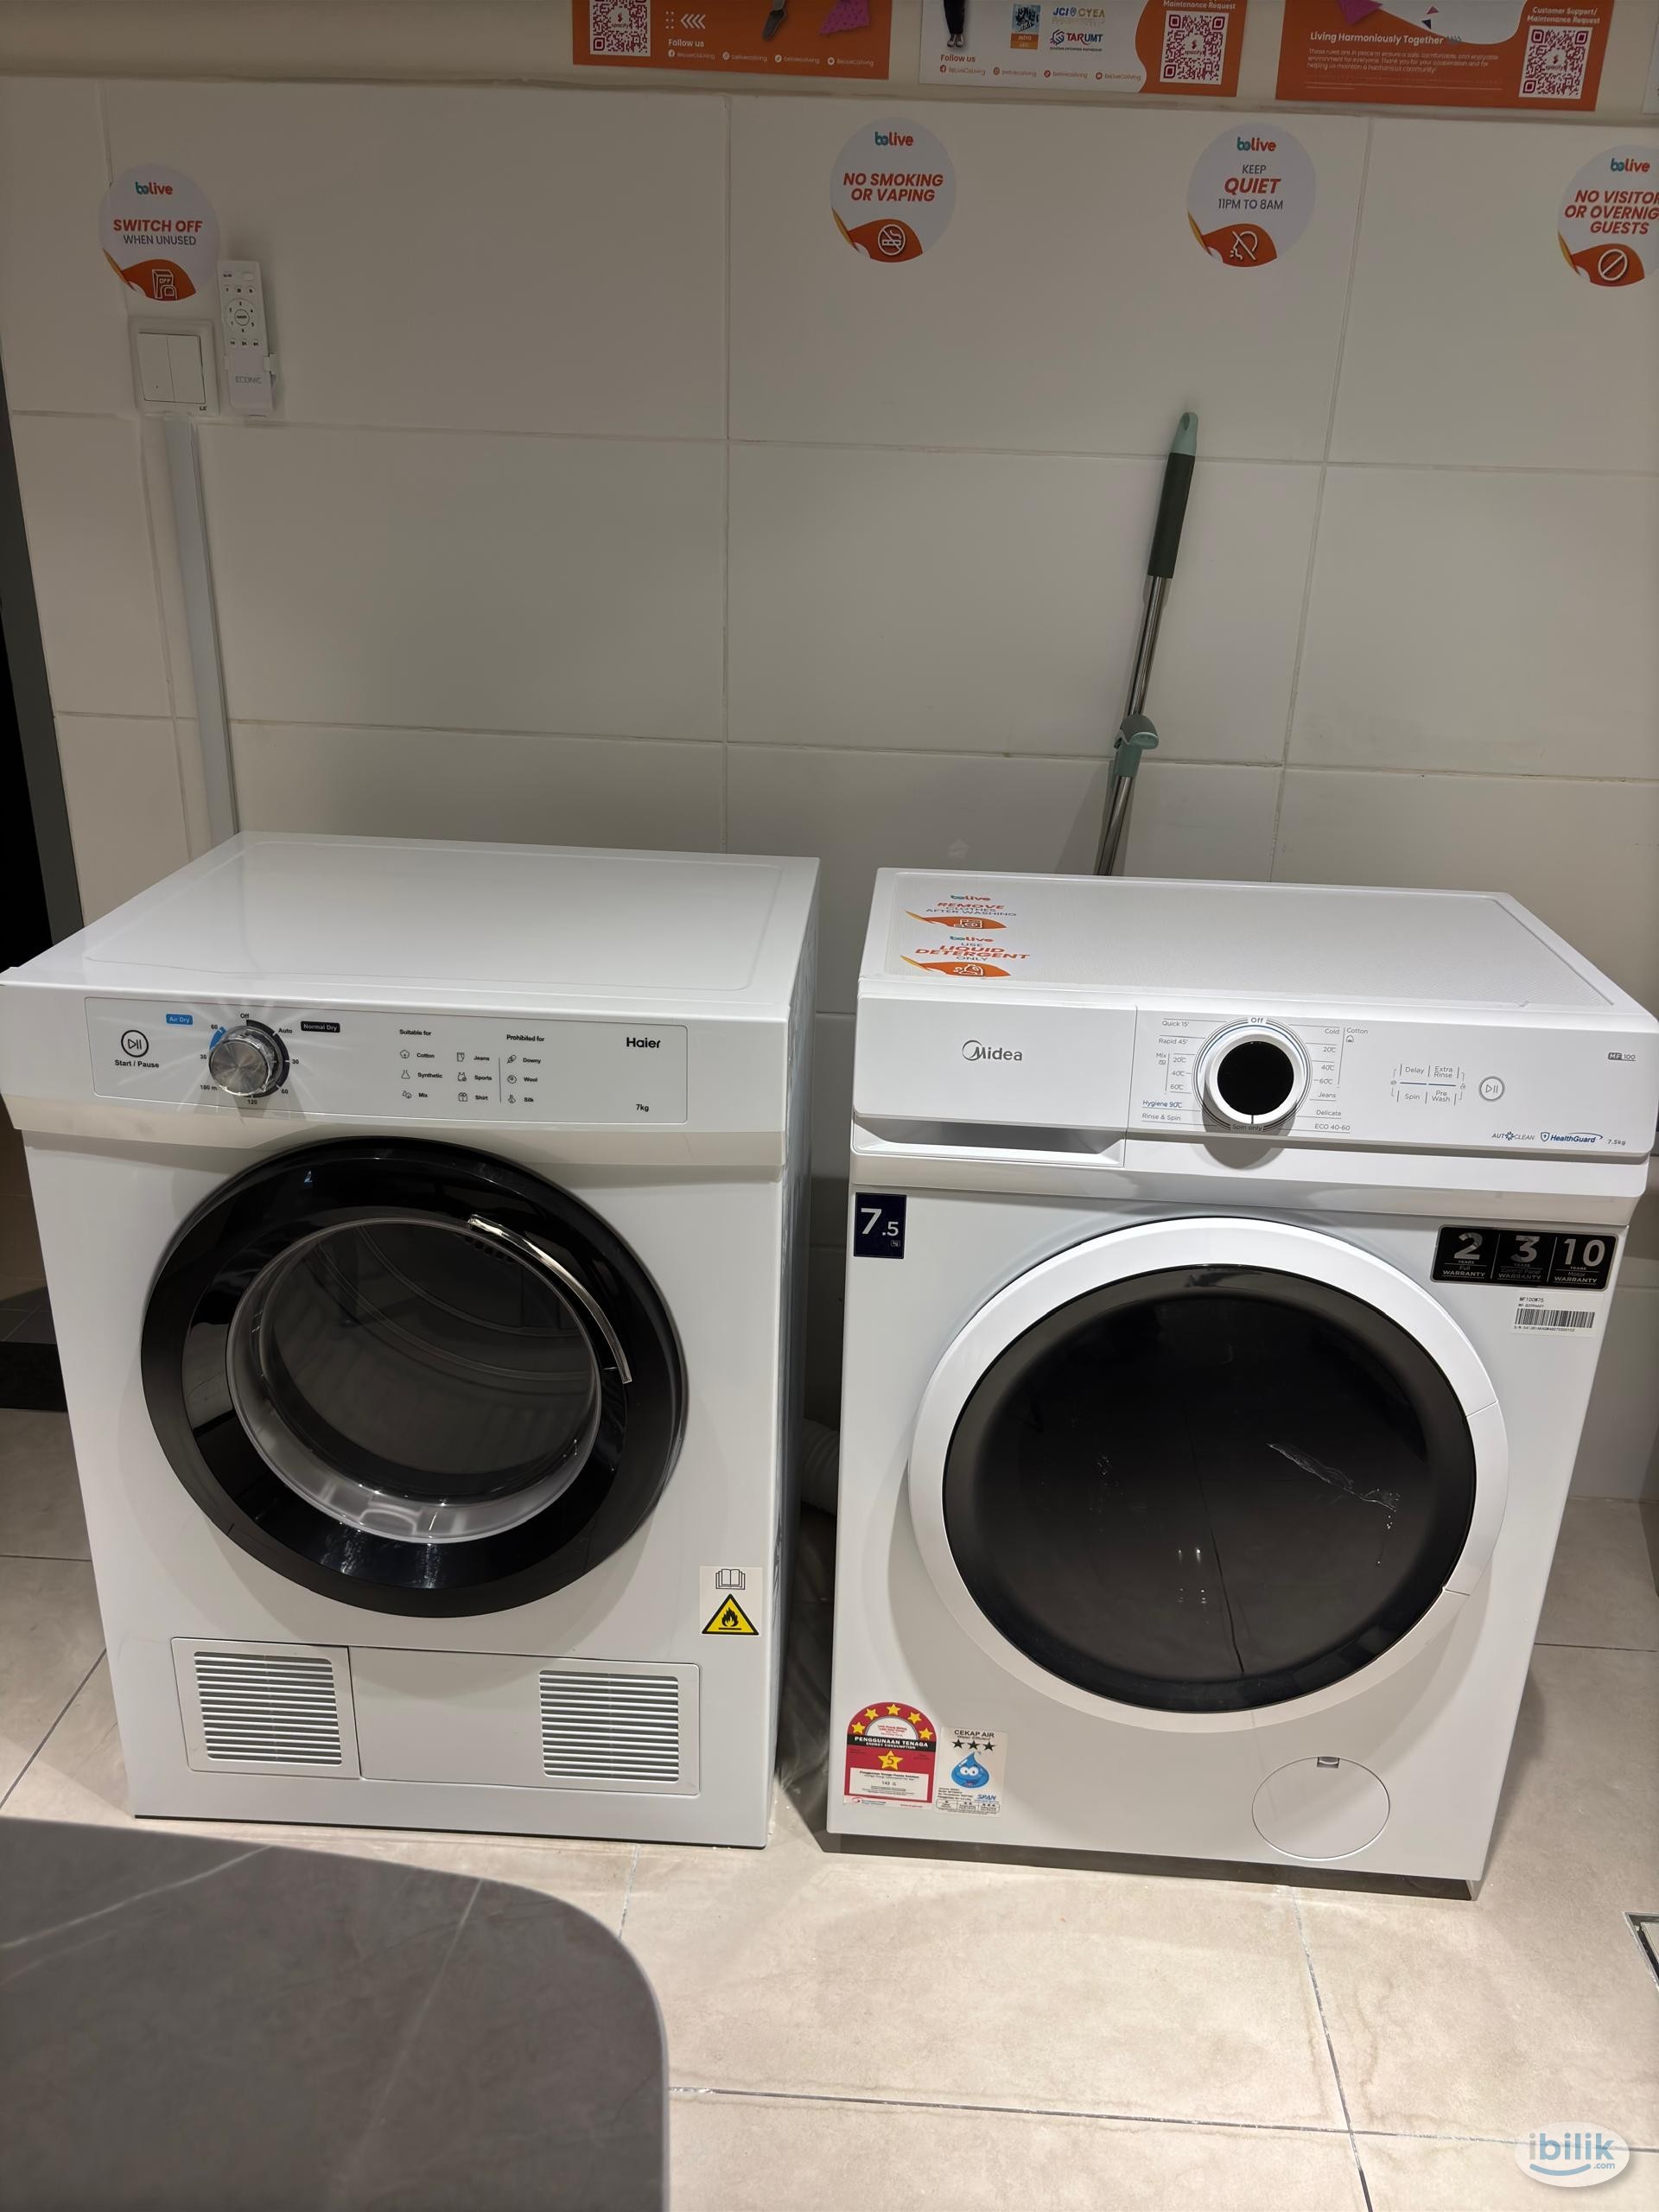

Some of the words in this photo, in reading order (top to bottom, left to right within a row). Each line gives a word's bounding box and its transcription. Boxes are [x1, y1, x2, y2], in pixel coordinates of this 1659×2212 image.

[1053, 7, 1069, 16] JCI
[1208, 2, 1236, 10] Request
[1572, 16, 1600, 24] Request
[668, 39, 693, 47] Follow
[1310, 32, 1337, 43] Living
[1338, 32, 1402, 45] Harmoniously
[1403, 35, 1445, 46] Together
[1242, 164, 1266, 174] KEEP
[843, 173, 867, 186] NO
[870, 173, 944, 187] SMOKING
[1224, 177, 1281, 195] QUIET
[851, 188, 872, 201] OR
[877, 189, 935, 202] VAPING
[1575, 190, 1599, 203] NO
[1218, 198, 1240, 209] 11PM
[1244, 199, 1257, 209] TO
[1260, 199, 1283, 210] 8AM
[1564, 205, 1587, 218] OR
[114, 219, 172, 232] SWITCH
[175, 220, 203, 232] OFF
[1590, 221, 1649, 235] GUESTS
[124, 234, 153, 244] WHEN
[156, 235, 197, 245] UNUSED
[915, 949, 1031, 960] DETERGENT
[179, 1016, 190, 1024] Dry
[626, 1037, 661, 1048] Haier
[962, 1040, 1023, 1061] Midea
[137, 1060, 159, 1069] Pause
[636, 1104, 649, 1112] 7kg
[1551, 1134, 1596, 1143] HealthGuard
[1454, 1232, 1483, 1260] 2
[1510, 1235, 1541, 1263] 3
[1564, 1238, 1605, 1267] 10
[855, 1736, 900, 1745] PENGGUNAAN
[887, 1755, 894, 1765] 5
